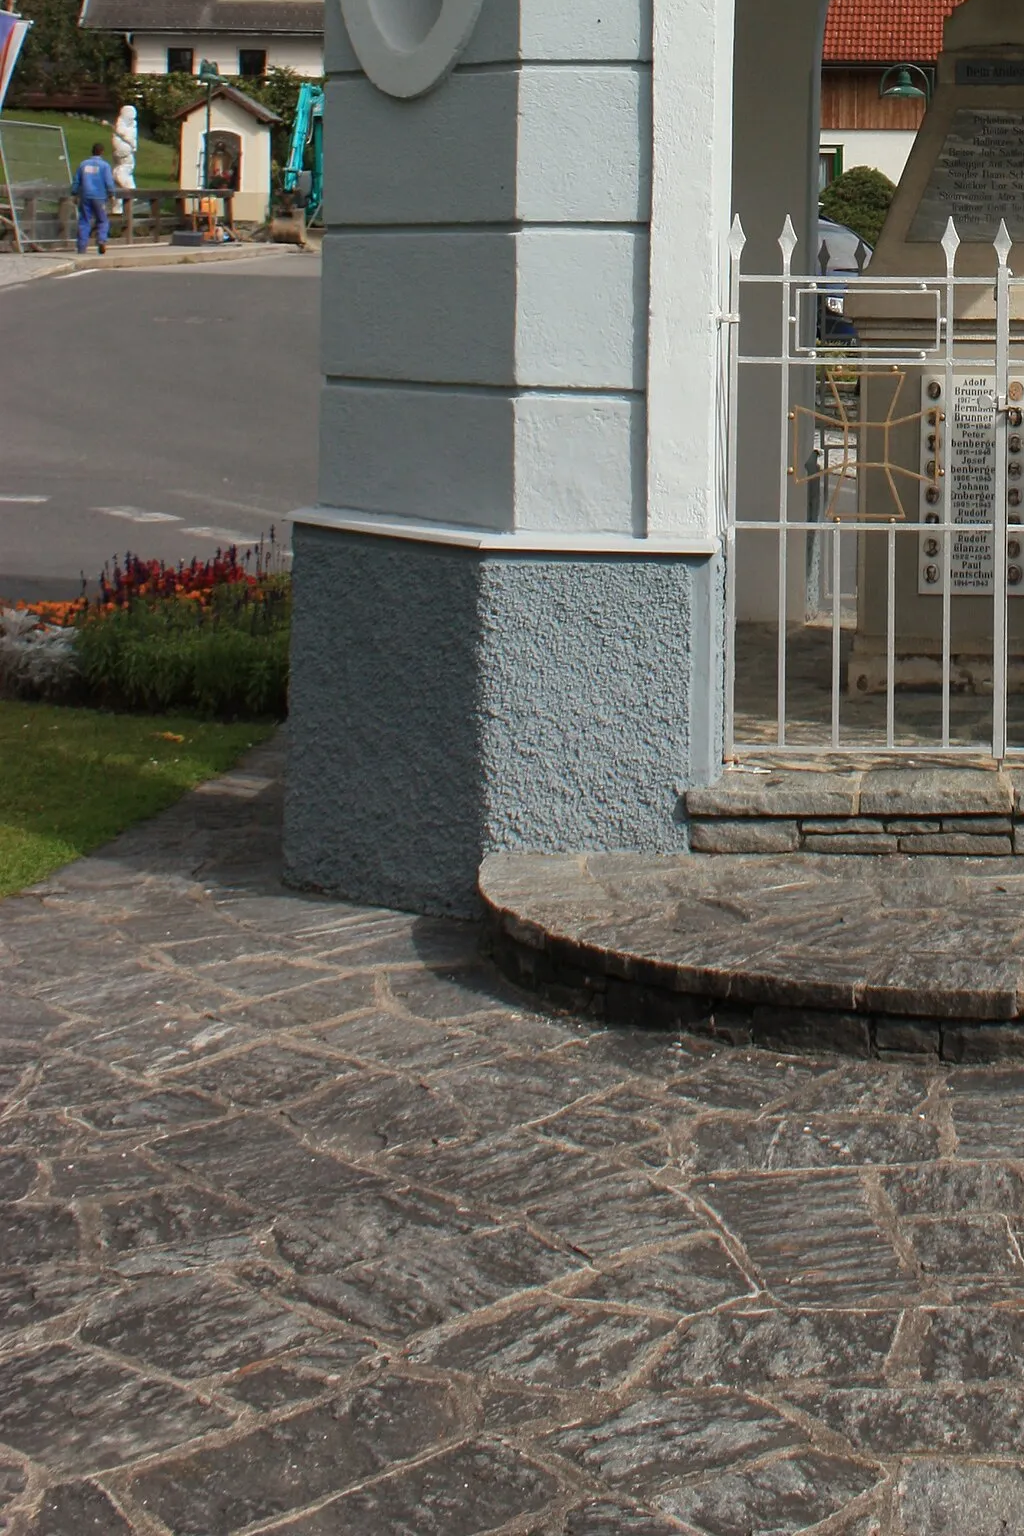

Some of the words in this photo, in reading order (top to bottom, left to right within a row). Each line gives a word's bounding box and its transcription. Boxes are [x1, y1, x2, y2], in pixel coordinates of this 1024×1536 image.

[963, 378, 986, 386] Adolf
[954, 386, 994, 396] Brunner
[954, 413, 993, 422] Brunner
[962, 430, 985, 438] Peter
[961, 456, 986, 464] Josef
[957, 482, 989, 491] Johann
[958, 508, 987, 517] Rudolf
[958, 534, 987, 543] Rudolf
[953, 543, 991, 552] Glanzer
[962, 561, 981, 569] Paul
